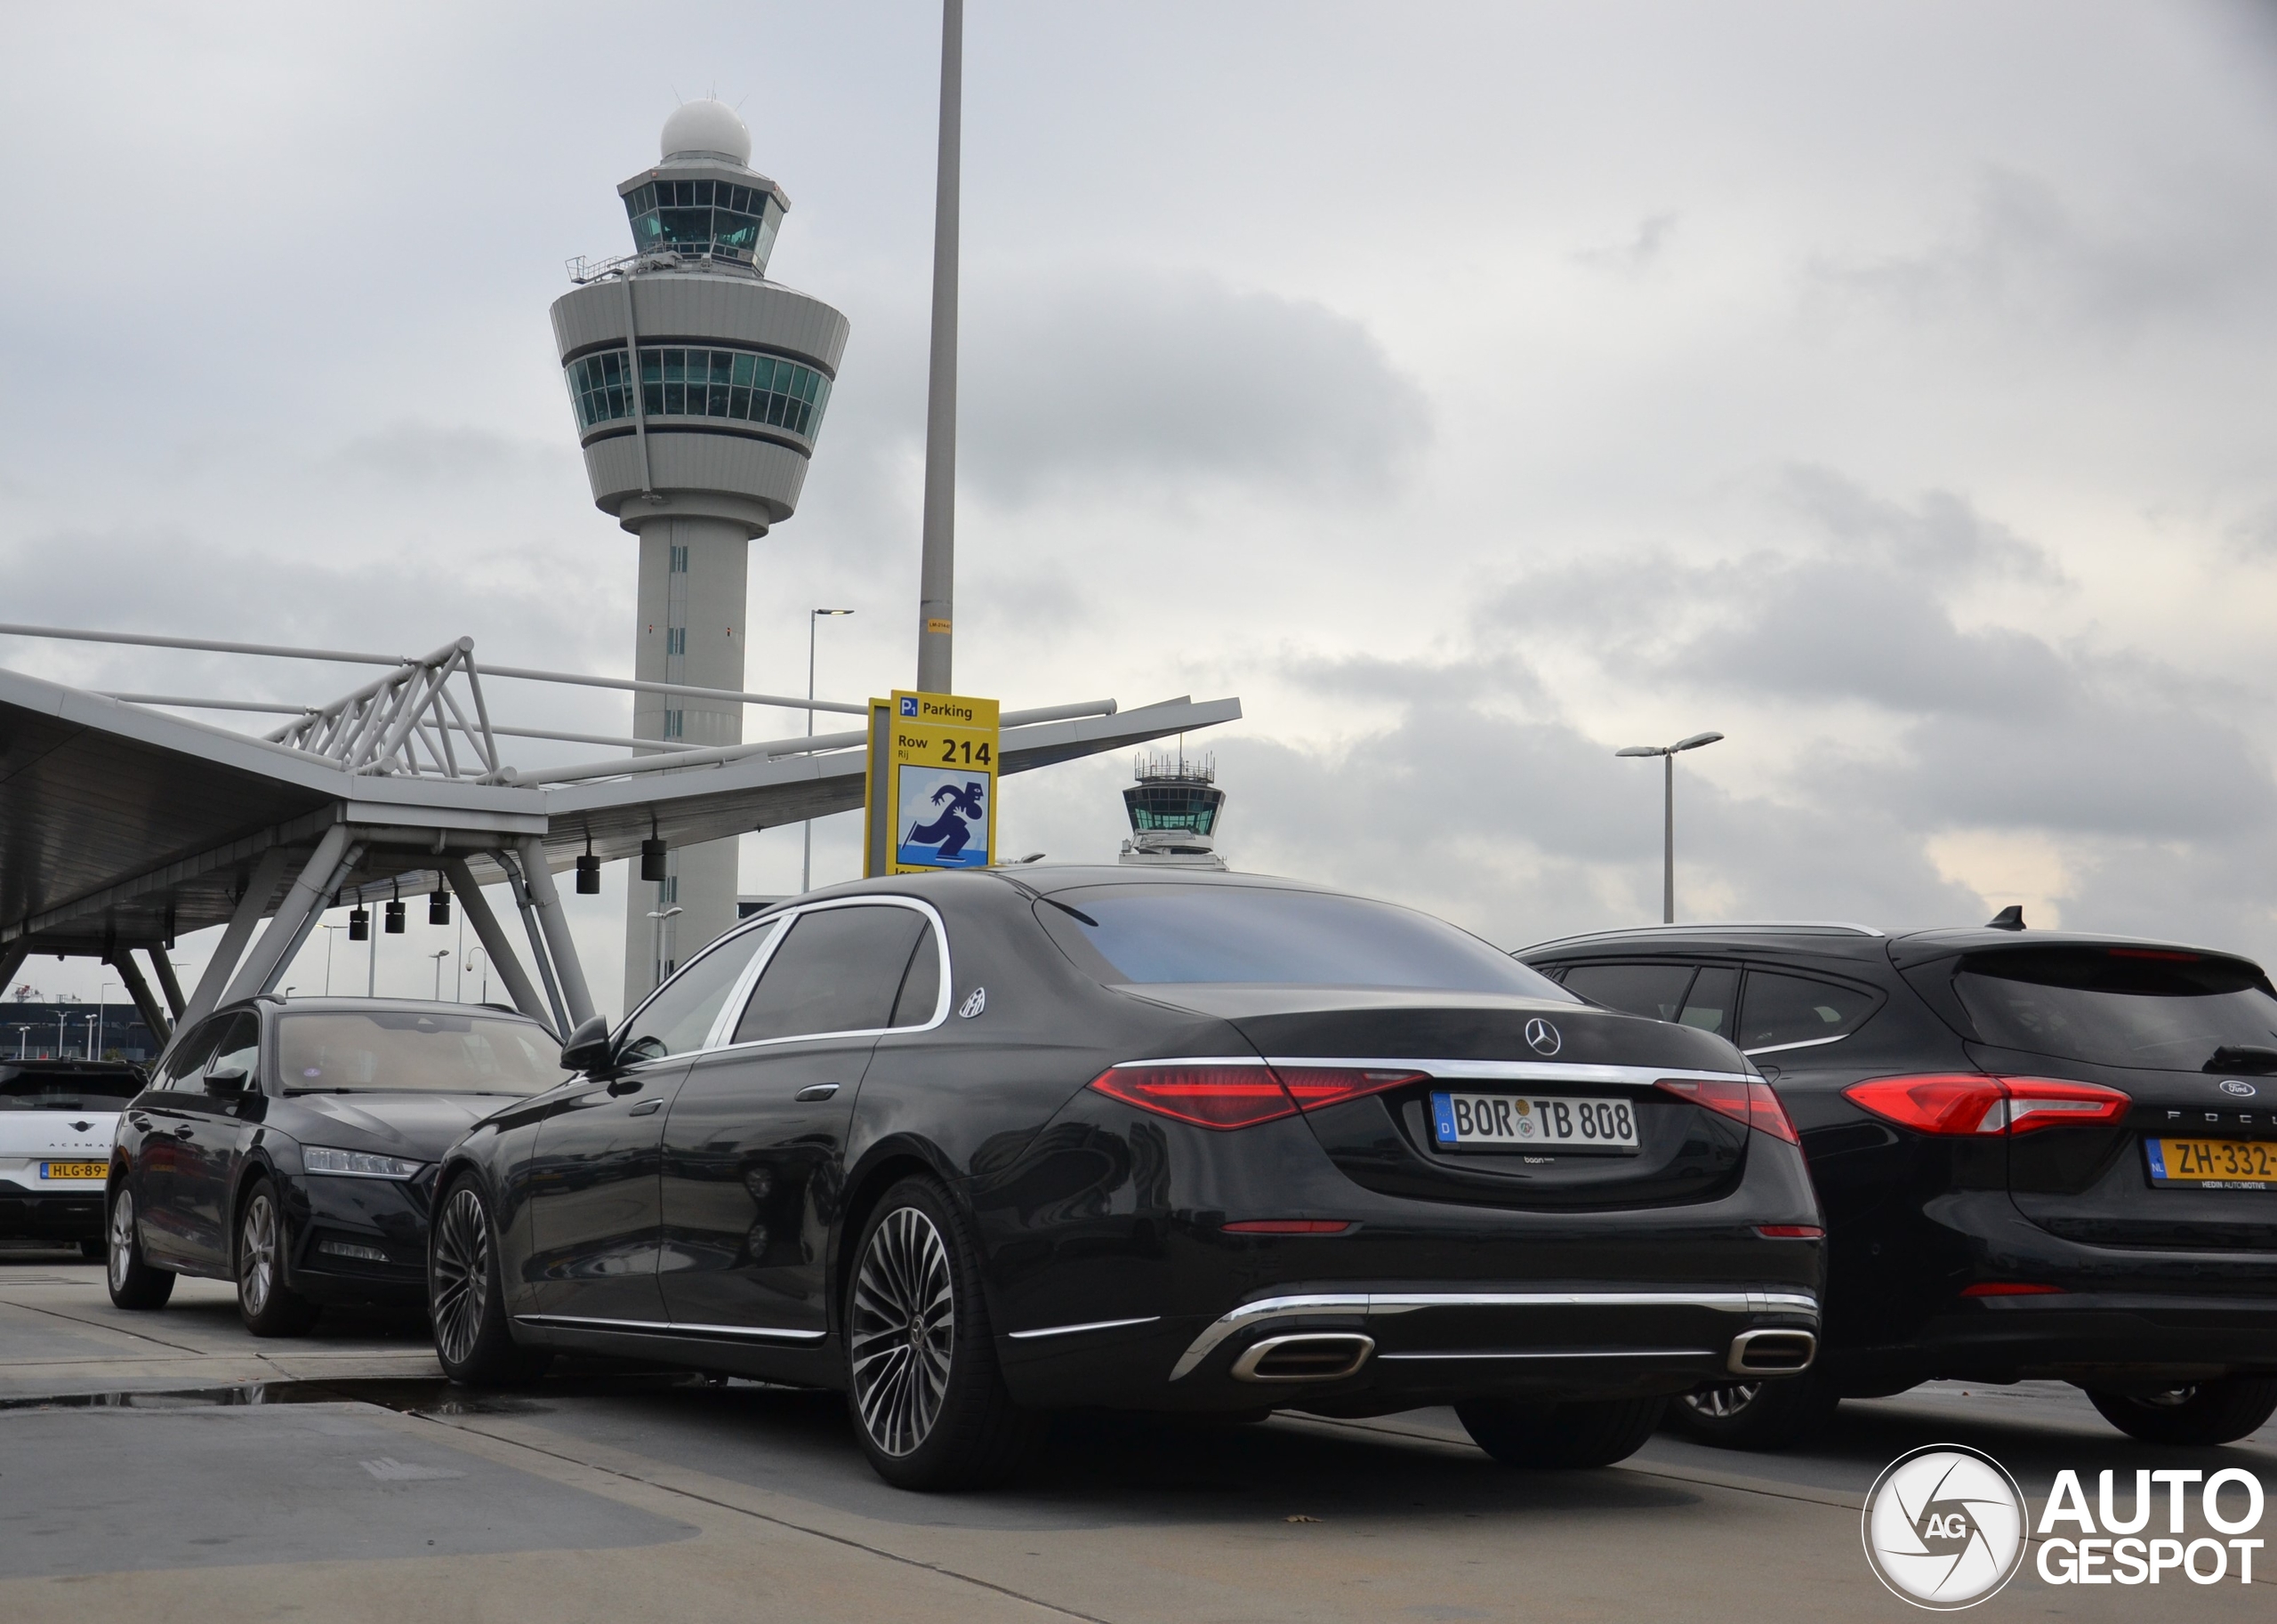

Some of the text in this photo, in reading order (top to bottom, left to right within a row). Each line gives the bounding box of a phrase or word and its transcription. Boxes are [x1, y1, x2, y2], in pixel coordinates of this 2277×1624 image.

[923, 702, 972, 721] Parking
[897, 750, 909, 760] Rij
[898, 735, 992, 766] Row 214
[2228, 1082, 2249, 1093] Ford
[1453, 1098, 1633, 1140] BOR TB 808
[1441, 1122, 1451, 1134] D
[1524, 1155, 1545, 1164] baan
[2152, 1163, 2164, 1173] NL
[2201, 1181, 2266, 1190] HEDIN AUTOMOTIVE
